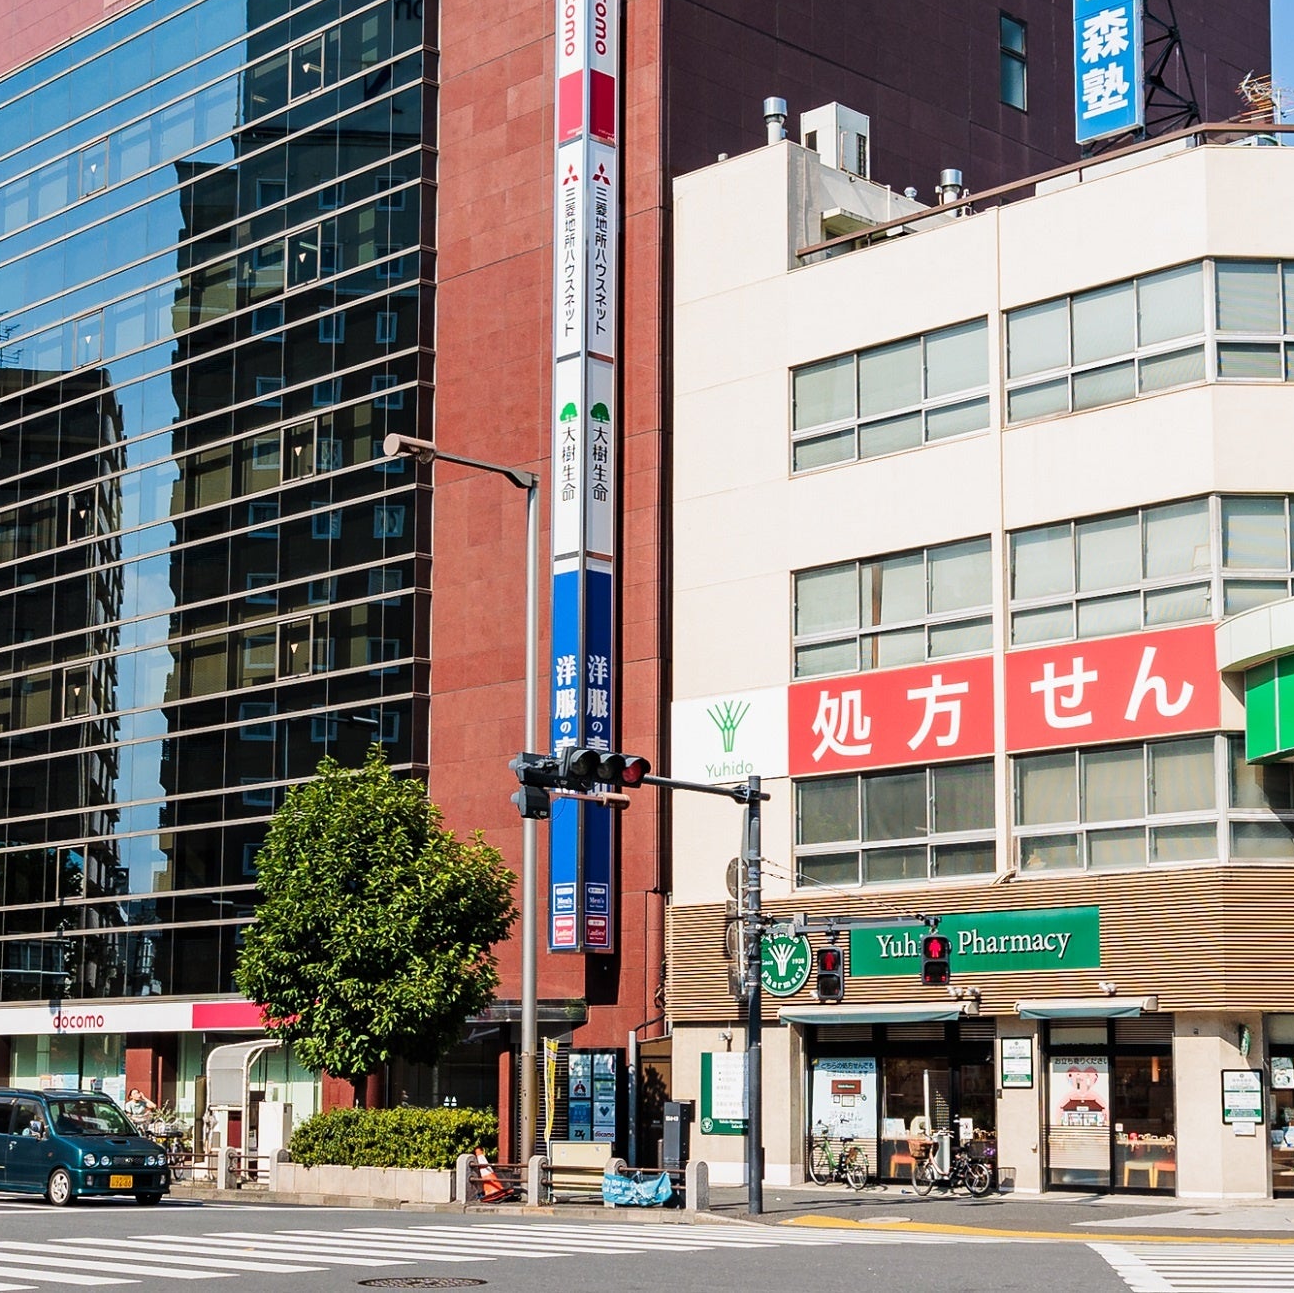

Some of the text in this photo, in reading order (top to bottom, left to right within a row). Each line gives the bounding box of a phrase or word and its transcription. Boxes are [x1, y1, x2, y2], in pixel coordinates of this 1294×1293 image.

[1081, 6, 1129, 120] 森塾
[563, 188, 577, 337] 三菱地所ハウスネット
[594, 187, 608, 336] 三菱地所ハウスネット
[562, 427, 576, 502] 大樹生命
[592, 426, 609, 502] 大樹生命
[811, 645, 1195, 763] 処方せん
[705, 762, 754, 778] Yuhido
[761, 965, 806, 990] Pharmacy
[957, 929, 1071, 959] Pharmacy
[53, 1010, 104, 1029] docomo
